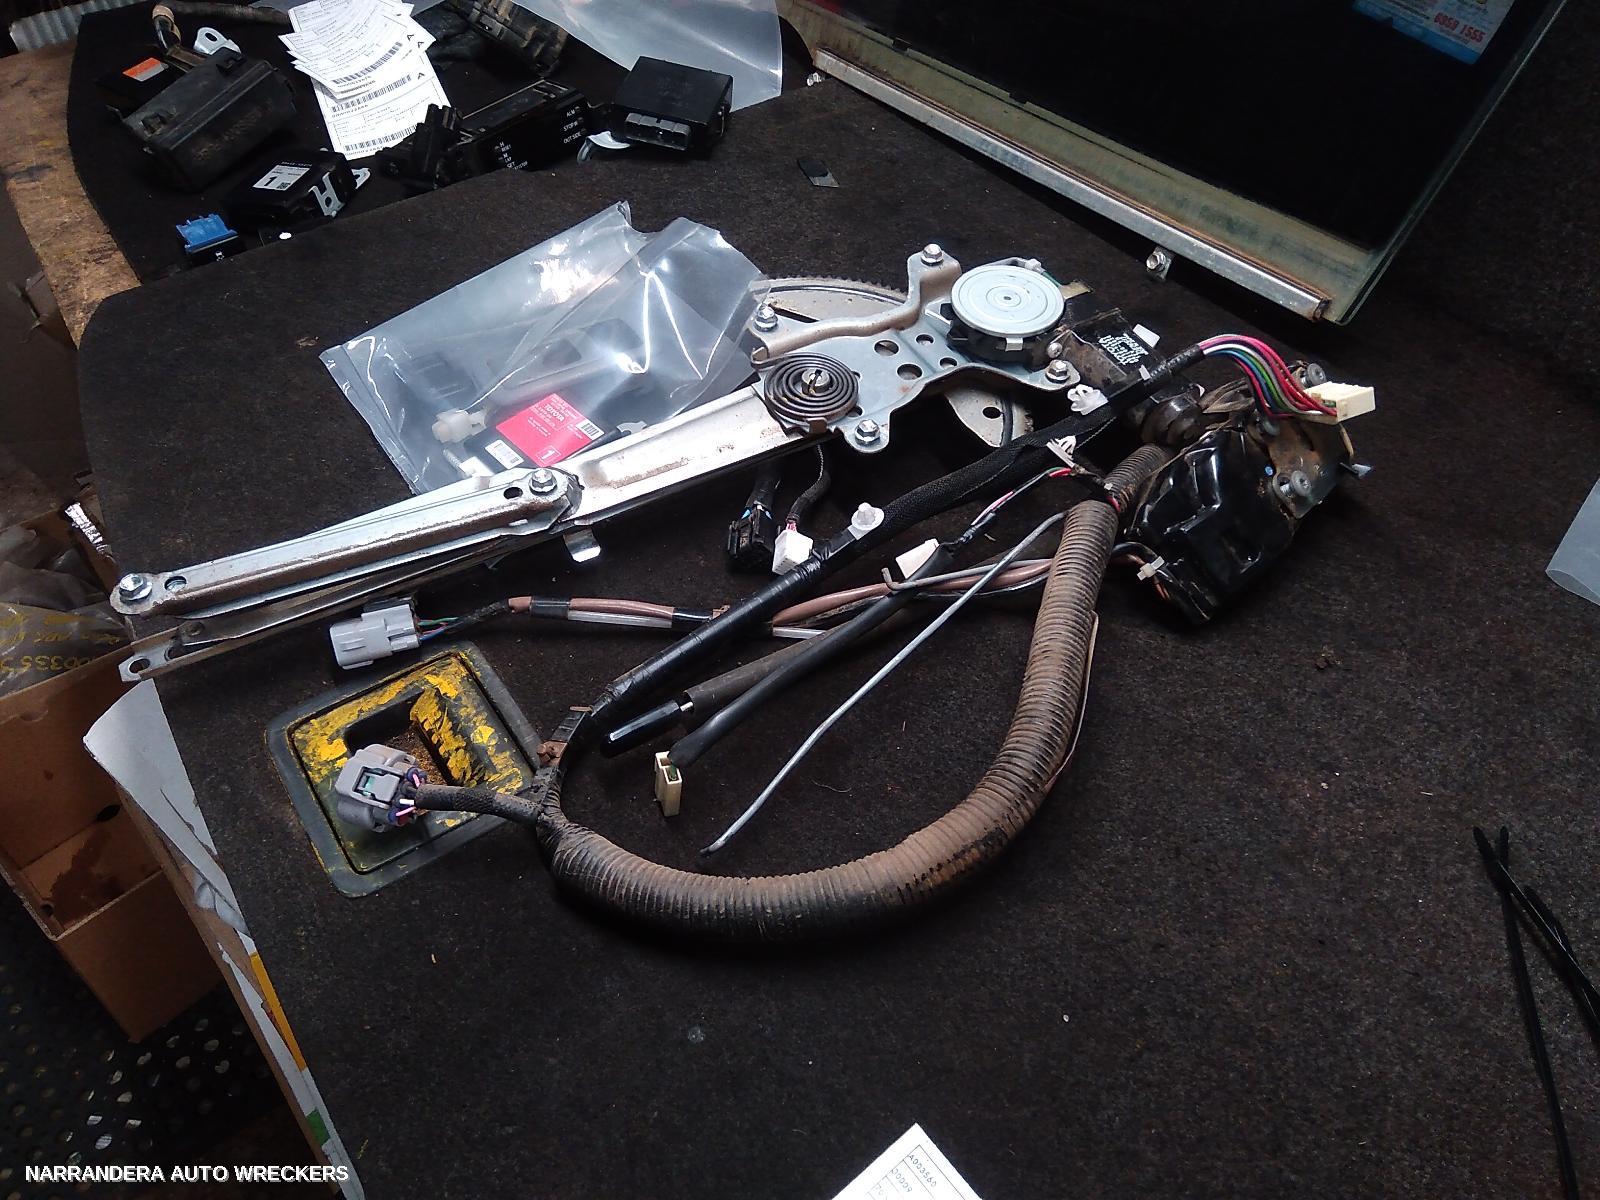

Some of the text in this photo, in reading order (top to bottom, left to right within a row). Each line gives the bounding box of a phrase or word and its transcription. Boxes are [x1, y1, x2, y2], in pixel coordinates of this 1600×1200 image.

[1460, 24, 1487, 43] 1555
[264, 176, 278, 187] 1
[1098, 338, 1127, 364] TOYOTA
[544, 404, 565, 422] TOYOTA
